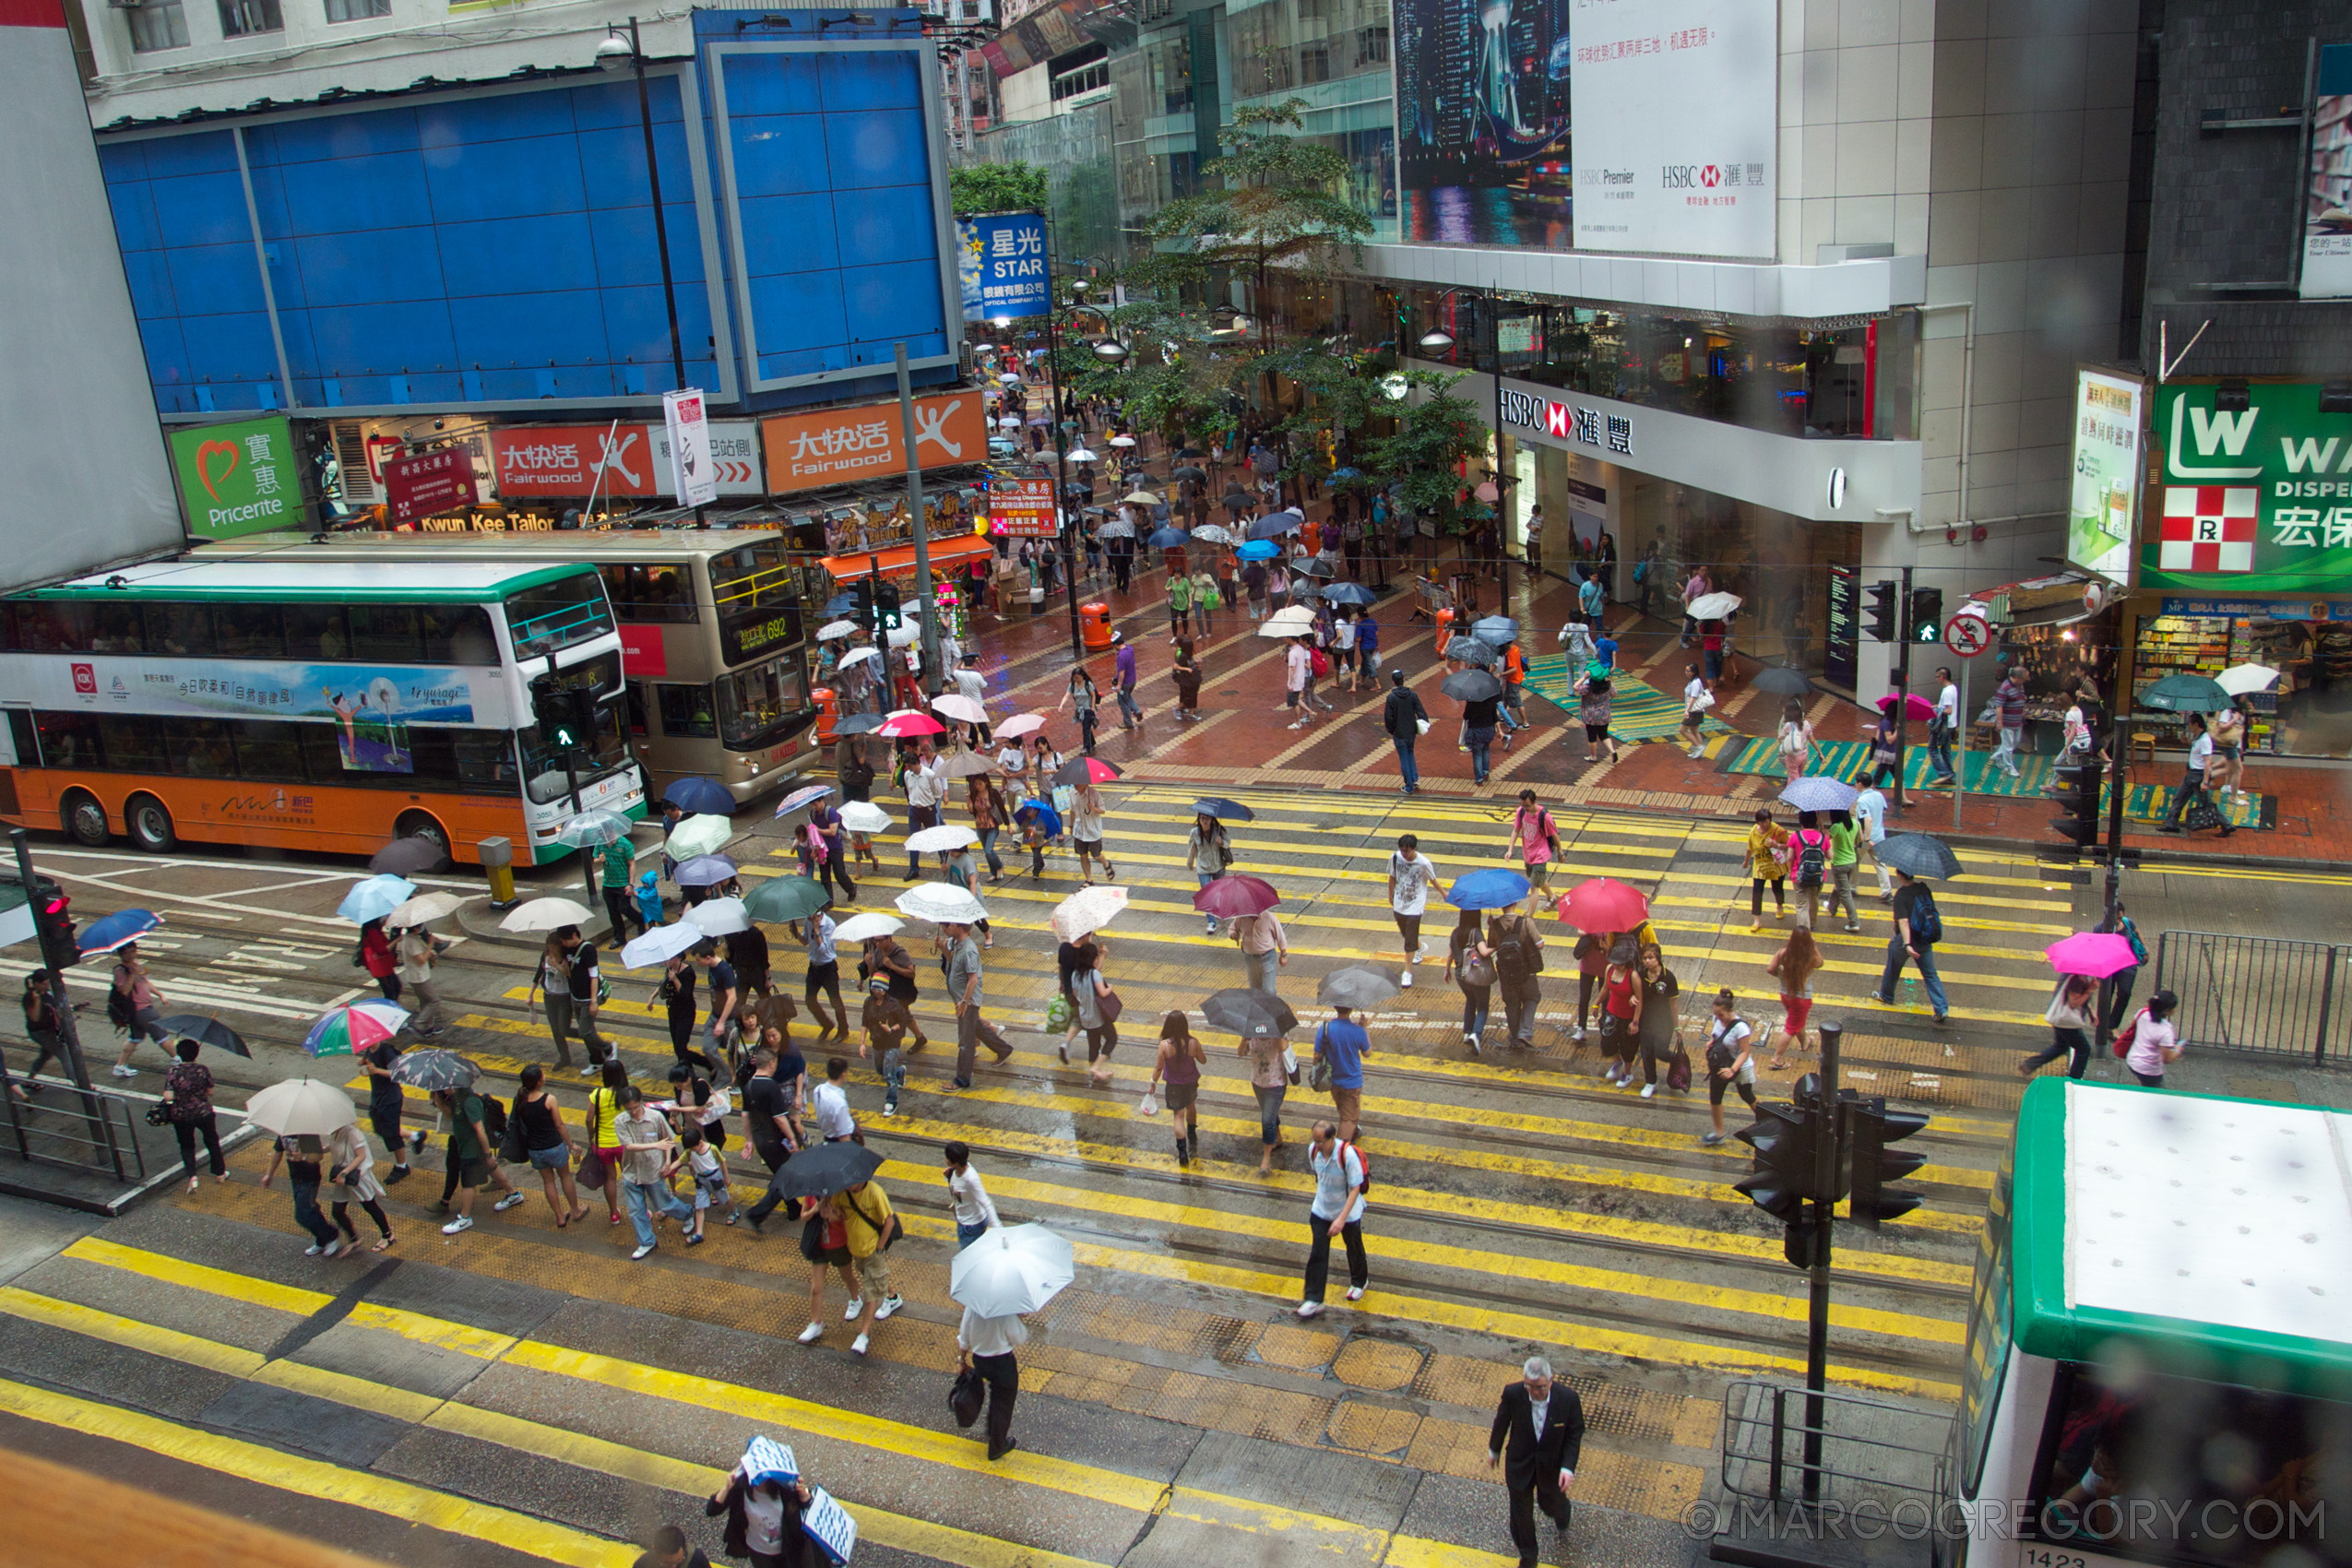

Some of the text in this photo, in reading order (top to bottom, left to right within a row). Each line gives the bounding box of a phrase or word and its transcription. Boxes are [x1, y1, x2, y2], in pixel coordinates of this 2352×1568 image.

[1580, 168, 1634, 185] HSBC Premier
[1662, 165, 1697, 188] HSBC
[992, 227, 1042, 257] 星光
[2309, 249, 2351, 257] Your Ultimate
[994, 258, 1043, 278] STAR
[983, 282, 1045, 298] 眼鏡有限公司
[1008, 297, 1033, 305] COMPANY
[1499, 387, 1547, 432] HSBC
[789, 420, 889, 461] 大快活
[244, 434, 281, 495] 實惠
[501, 444, 579, 469] 大快活
[791, 450, 892, 477] Fairwood
[2280, 437, 2352, 473] W
[505, 471, 583, 484] Fairwood
[2275, 481, 2352, 497] DISPE
[208, 499, 283, 527] Pricerite
[421, 513, 555, 532] Kwun Kee Tailor
[845, 533, 861, 548] SUN
[868, 526, 901, 544] CHEUNG
[766, 617, 787, 640] 692
[536, 811, 552, 819] 3055
[1255, 1026, 1267, 1034] citi
